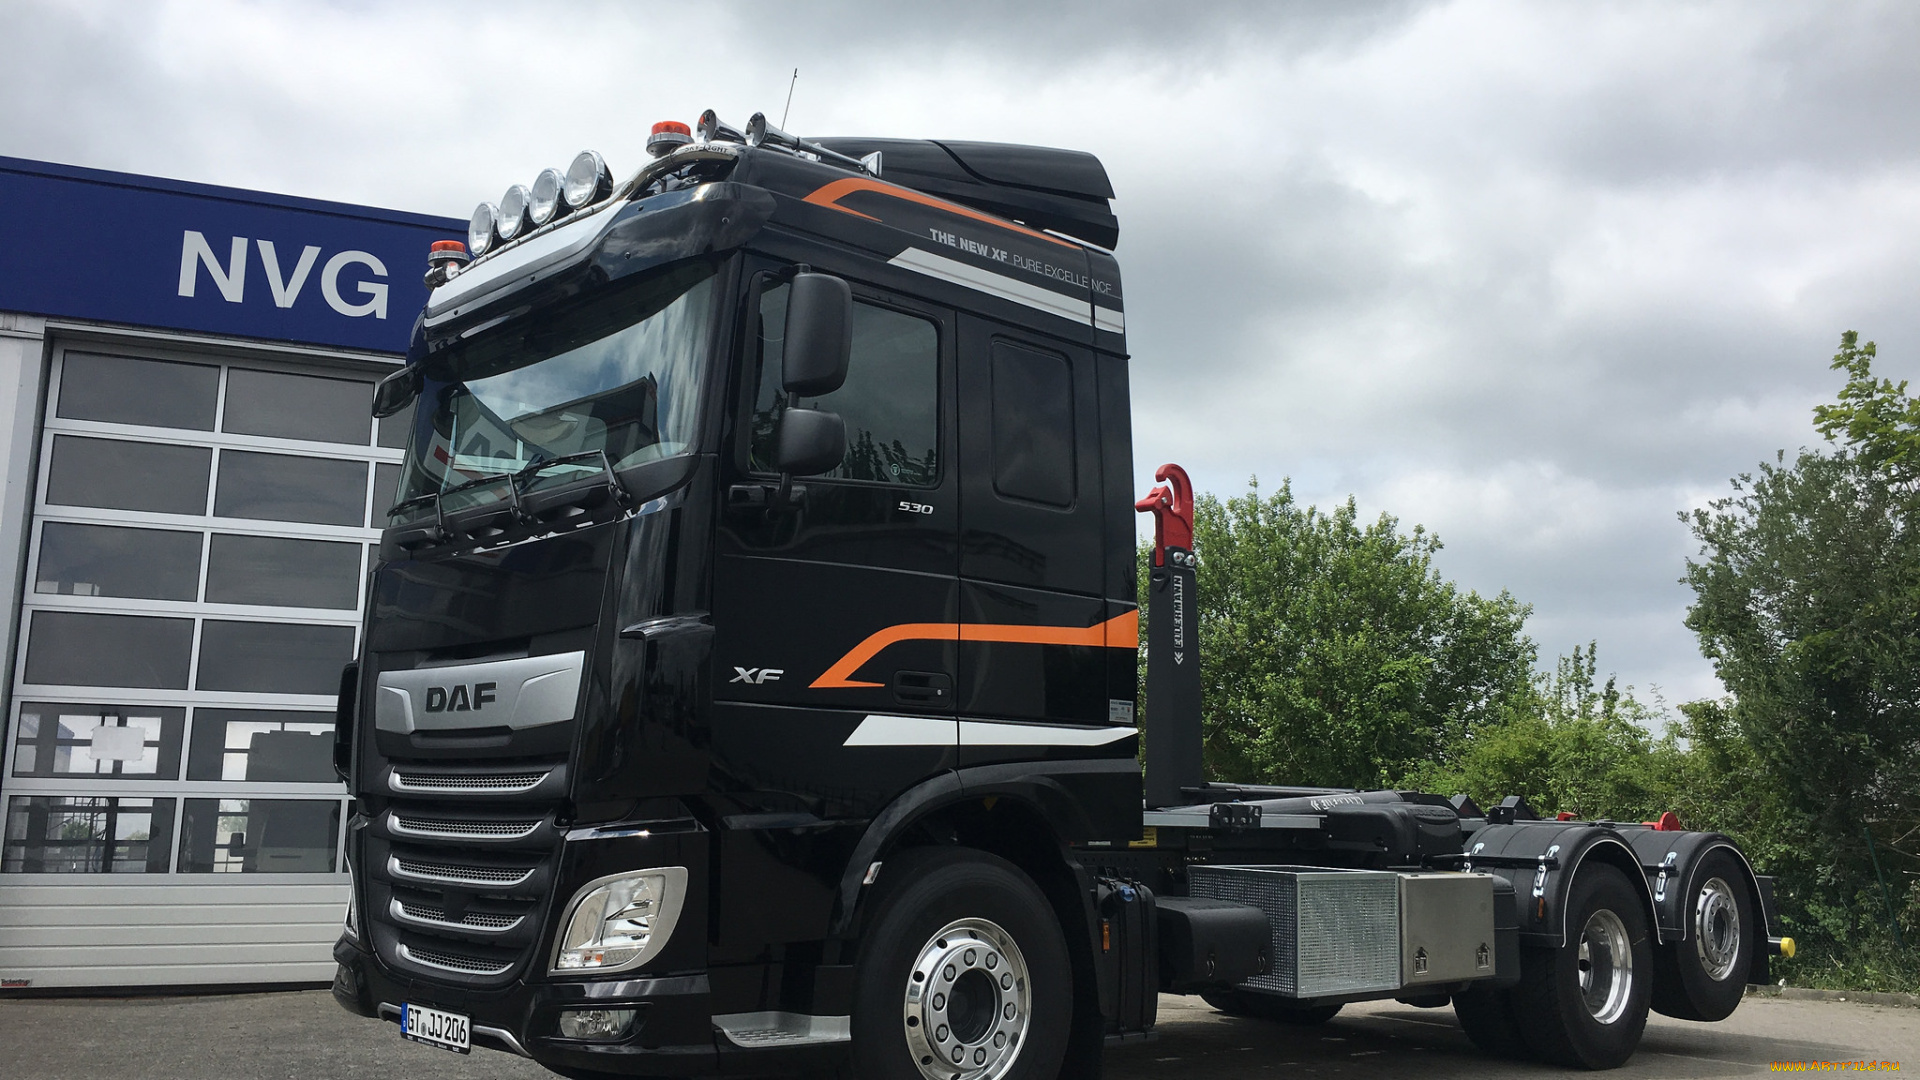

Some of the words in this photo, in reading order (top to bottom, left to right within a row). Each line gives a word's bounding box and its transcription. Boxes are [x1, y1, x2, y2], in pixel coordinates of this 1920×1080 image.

[929, 228, 956, 247] THE
[959, 237, 988, 257] NEW
[991, 247, 1008, 262] XF
[1013, 254, 1042, 274] PURE
[178, 230, 389, 320] NVG
[898, 501, 934, 515] 530
[1173, 575, 1184, 649] ELLERMANN
[729, 666, 784, 684] XF
[425, 681, 498, 713] DAF
[407, 1007, 421, 1033] GT
